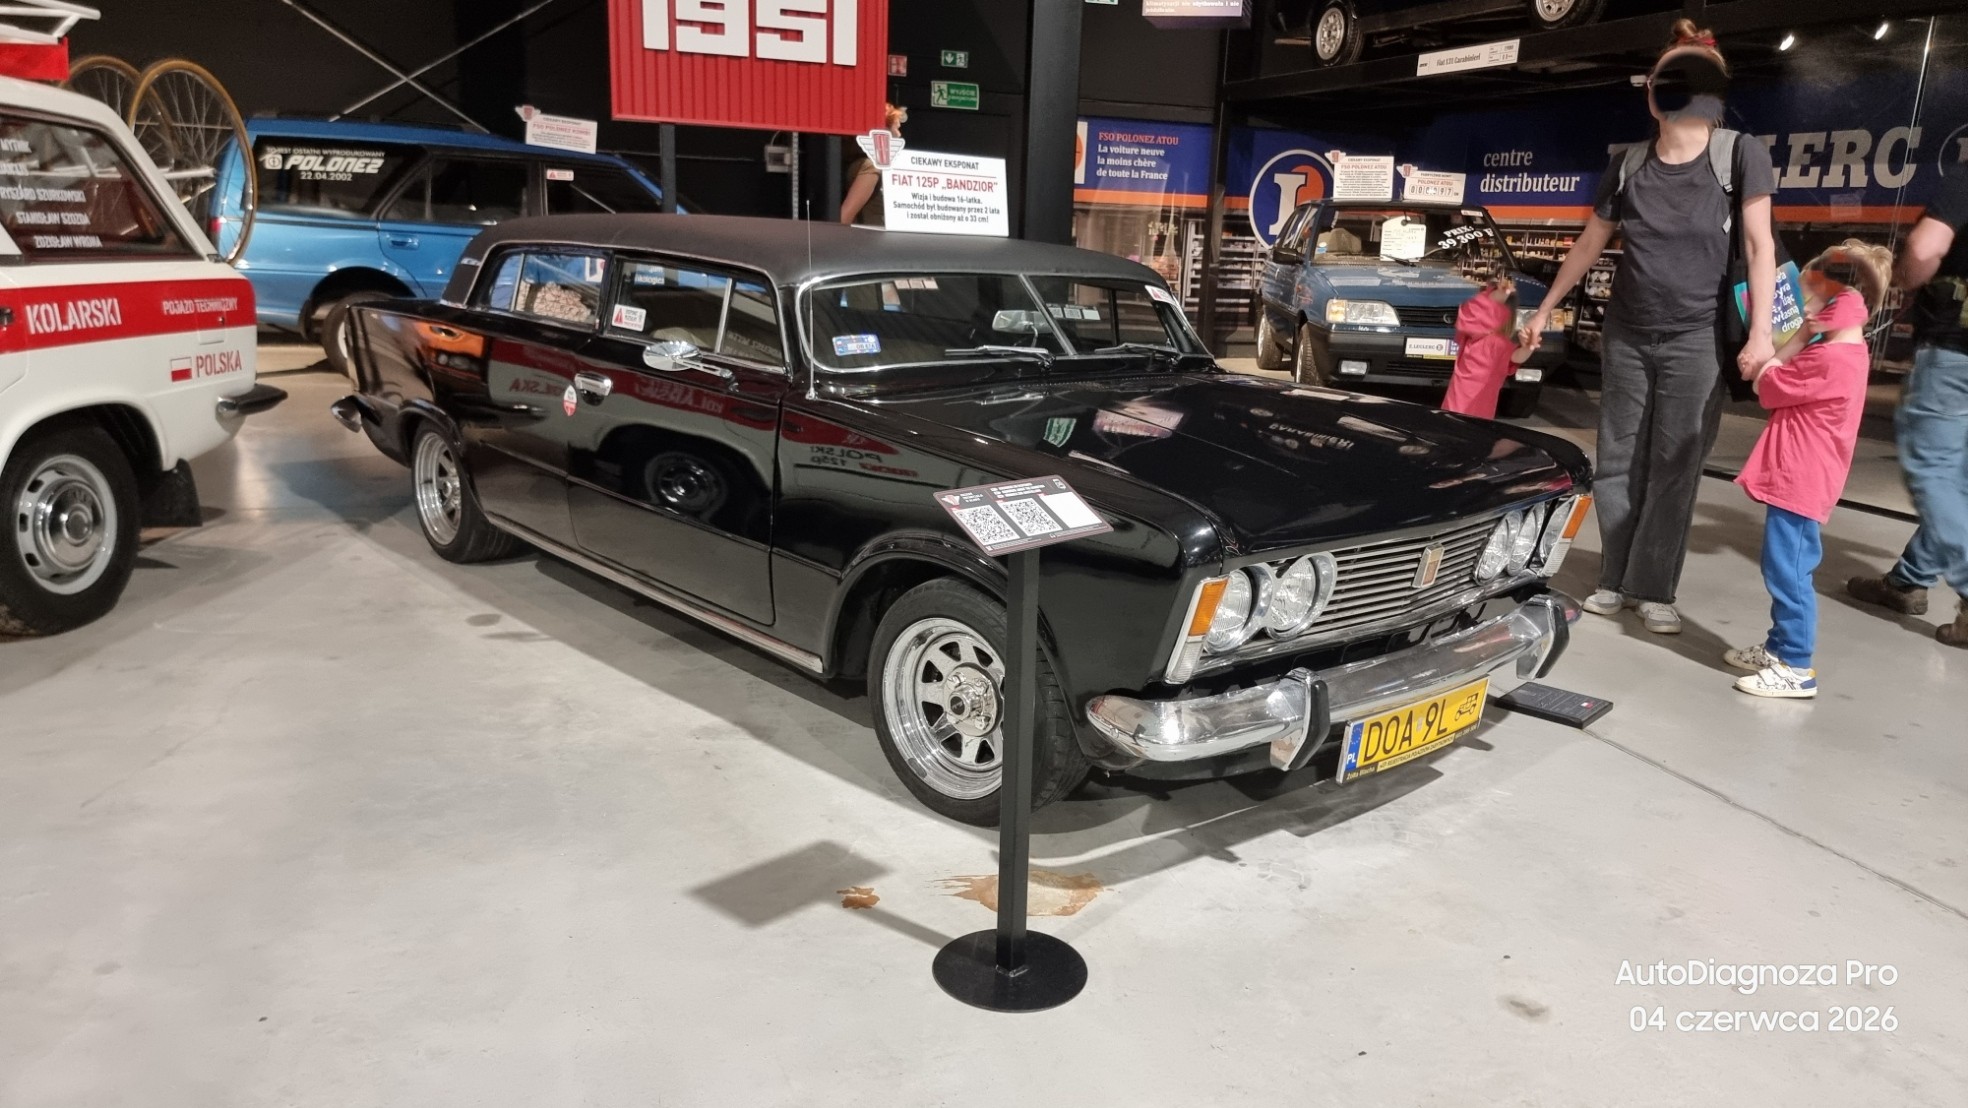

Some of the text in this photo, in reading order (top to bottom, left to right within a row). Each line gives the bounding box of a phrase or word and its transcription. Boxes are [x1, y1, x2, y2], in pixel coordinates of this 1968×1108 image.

[642, 0, 858, 66] 1951
[1098, 132, 1179, 145] FSO POLONEZ ATOU
[1098, 144, 1108, 153] La
[1109, 144, 1139, 155] voiture
[283, 155, 385, 174] POLONEZ
[911, 156, 979, 170] CIEKAWY EKSPONAT
[1097, 156, 1156, 168] la moins chère
[1483, 148, 1533, 167] centre
[300, 172, 353, 181] 22.04.2002
[891, 174, 913, 187] FIAT
[916, 176, 939, 188] 125P
[1096, 168, 1168, 180] de toute la France
[1480, 172, 1580, 193] distributeur
[911, 192, 928, 202] Wizja
[893, 201, 925, 211] Samochód
[937, 203, 966, 213] budowany
[967, 206, 983, 215] przez
[910, 212, 929, 220] został
[930, 213, 956, 223] obniżony
[969, 215, 977, 223] 33
[978, 215, 989, 223] cm!
[1438, 227, 1495, 250] 39 300 F
[1443, 225, 1474, 238] PRIX:
[162, 300, 195, 316] POJAZD
[25, 298, 122, 335] KOLARSKI
[196, 350, 242, 377] POLSKA
[1364, 699, 1448, 762] DOA 9L
[1347, 753, 1356, 765] PL
